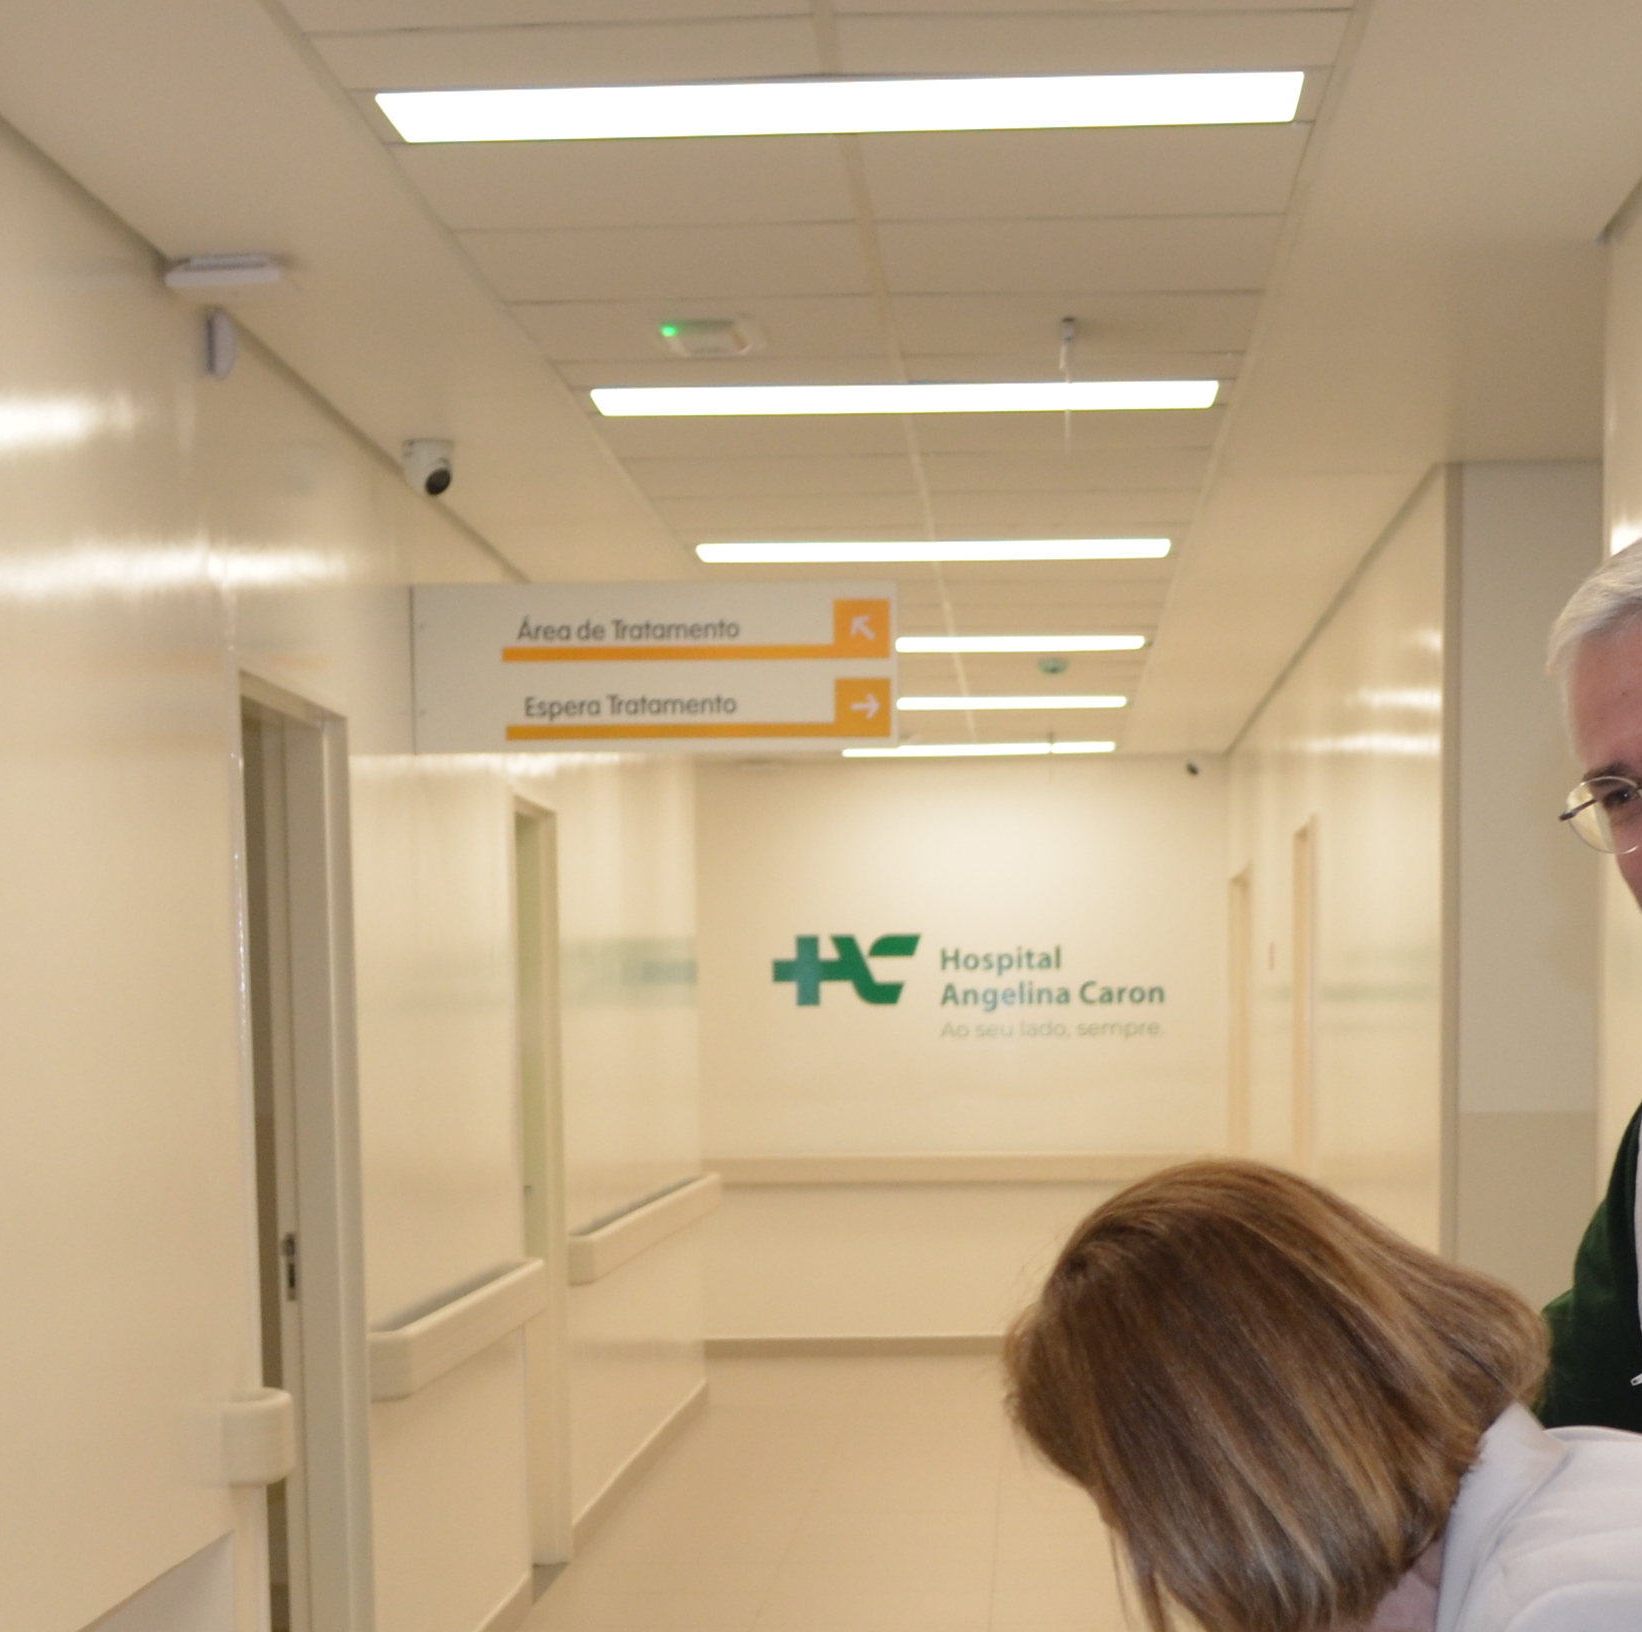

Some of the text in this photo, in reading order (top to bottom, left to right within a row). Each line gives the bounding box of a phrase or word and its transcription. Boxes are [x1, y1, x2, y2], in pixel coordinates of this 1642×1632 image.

[516, 615, 741, 641] Área de Tratamento
[524, 694, 738, 721] Espera Tratamento
[940, 945, 1062, 977] Hospital
[940, 980, 1165, 1012] Angelina Caron
[940, 1021, 970, 1038] Ao
[975, 1023, 1014, 1039] seu
[1019, 1020, 1071, 1040] lado,
